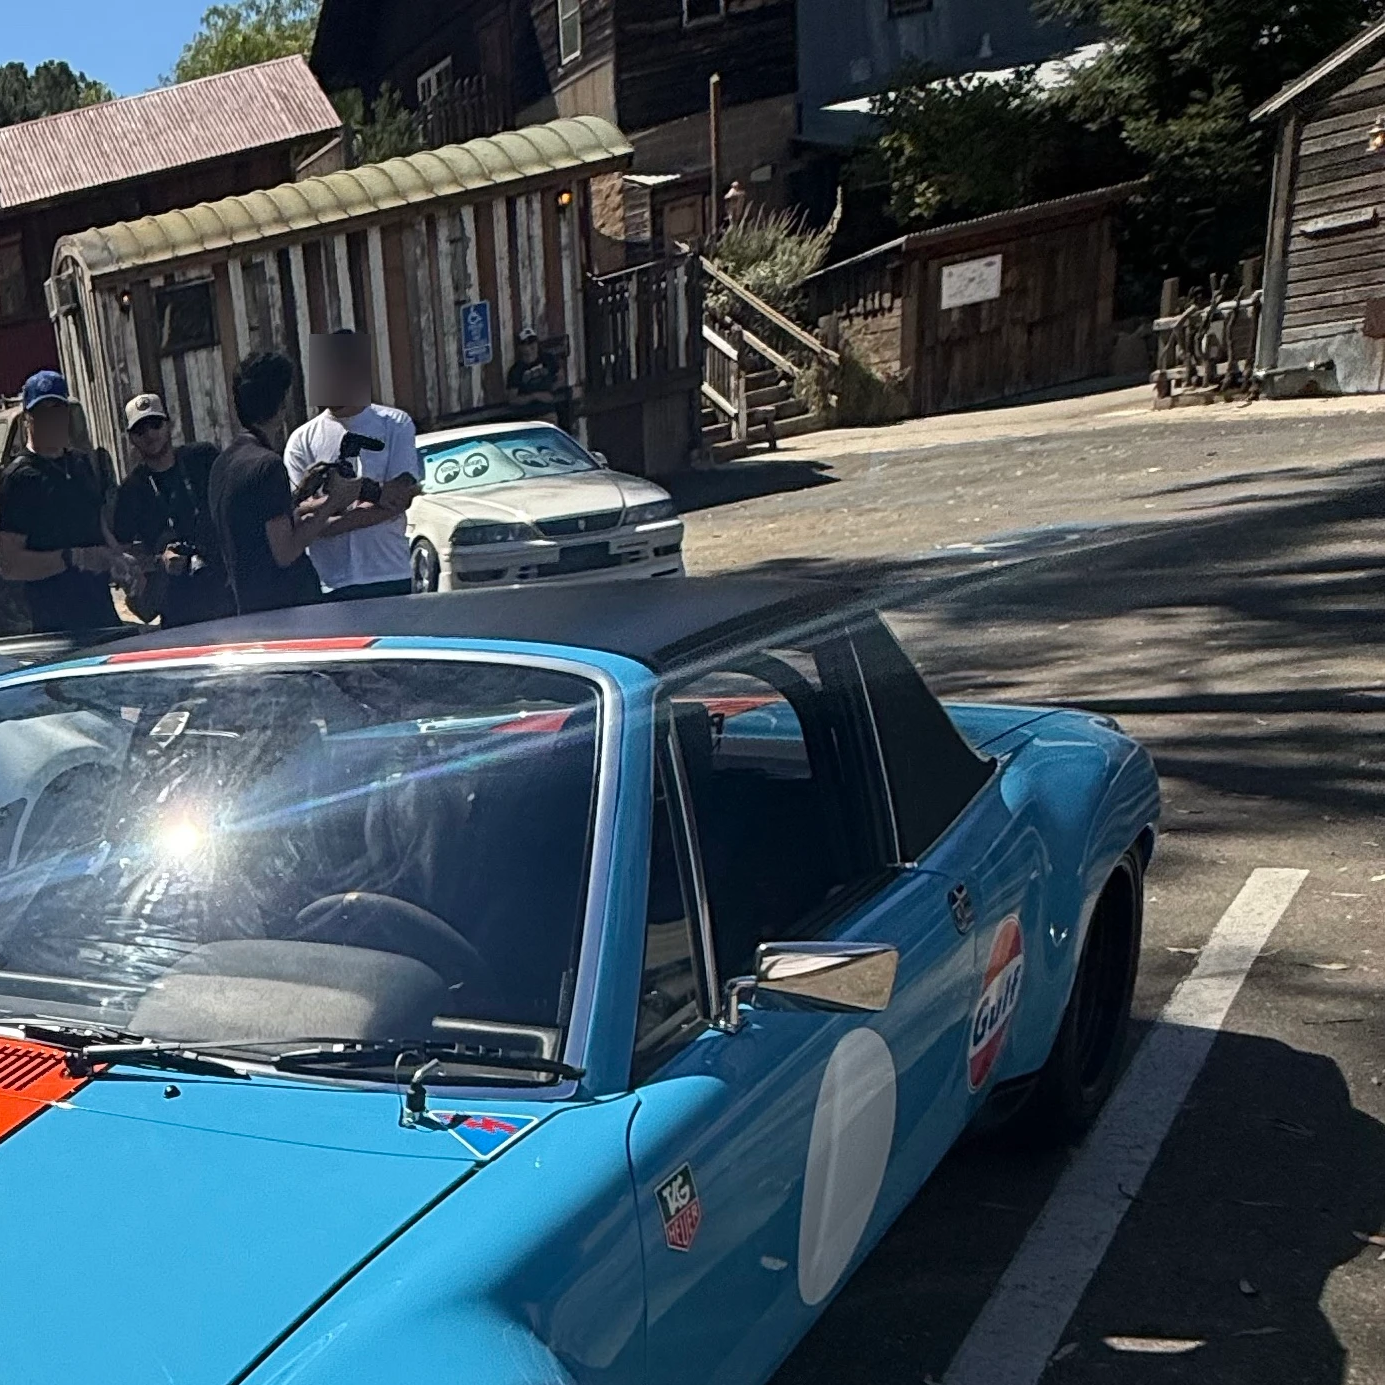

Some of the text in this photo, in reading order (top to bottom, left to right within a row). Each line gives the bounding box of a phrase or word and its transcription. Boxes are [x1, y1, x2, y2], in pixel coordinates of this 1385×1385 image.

[973, 964, 1022, 1046] Gulf
[662, 1175, 690, 1215] TAG
[668, 1203, 698, 1246] HEUER
